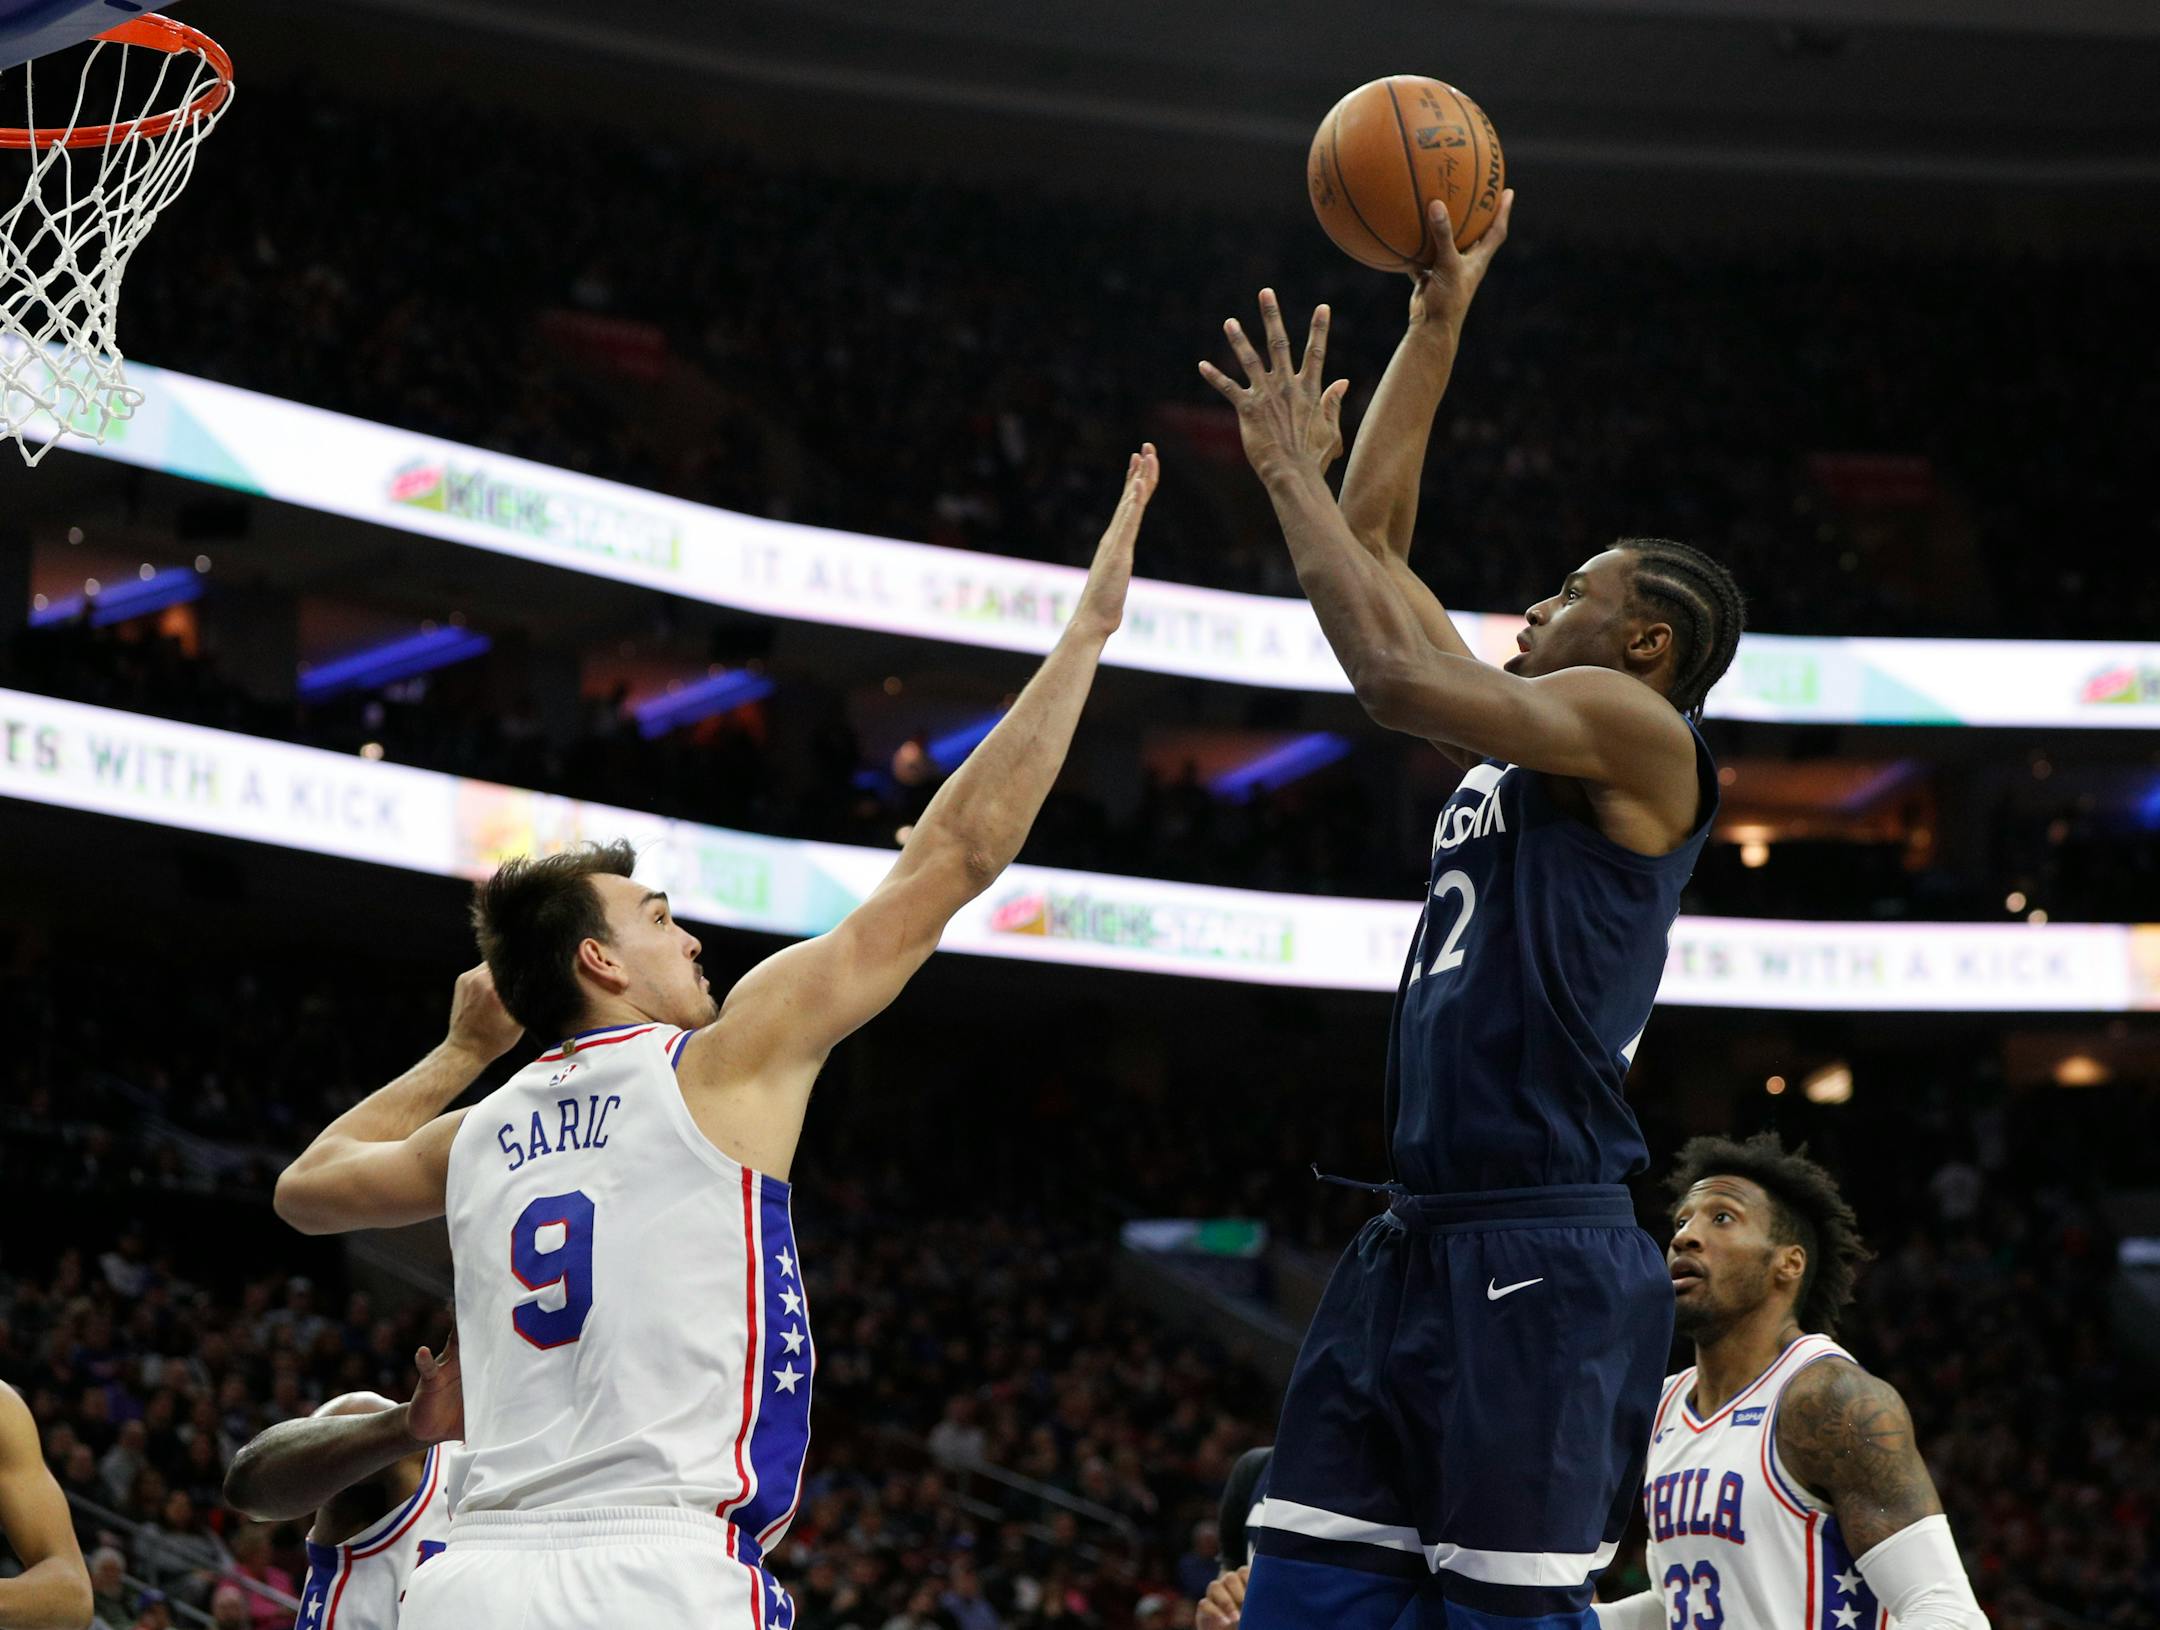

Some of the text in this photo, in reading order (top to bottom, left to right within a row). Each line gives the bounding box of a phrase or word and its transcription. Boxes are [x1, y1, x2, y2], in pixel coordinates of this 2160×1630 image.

[85, 730, 226, 807] WITH
[236, 762, 270, 812] A
[286, 775, 405, 838] KICK
[1755, 940, 1886, 988] WITH
[1902, 944, 1934, 984] A
[1951, 944, 2074, 986] KICK
[497, 1095, 621, 1172] SARIC
[510, 1189, 595, 1351] 9
[1664, 1560, 1725, 1630] 33
